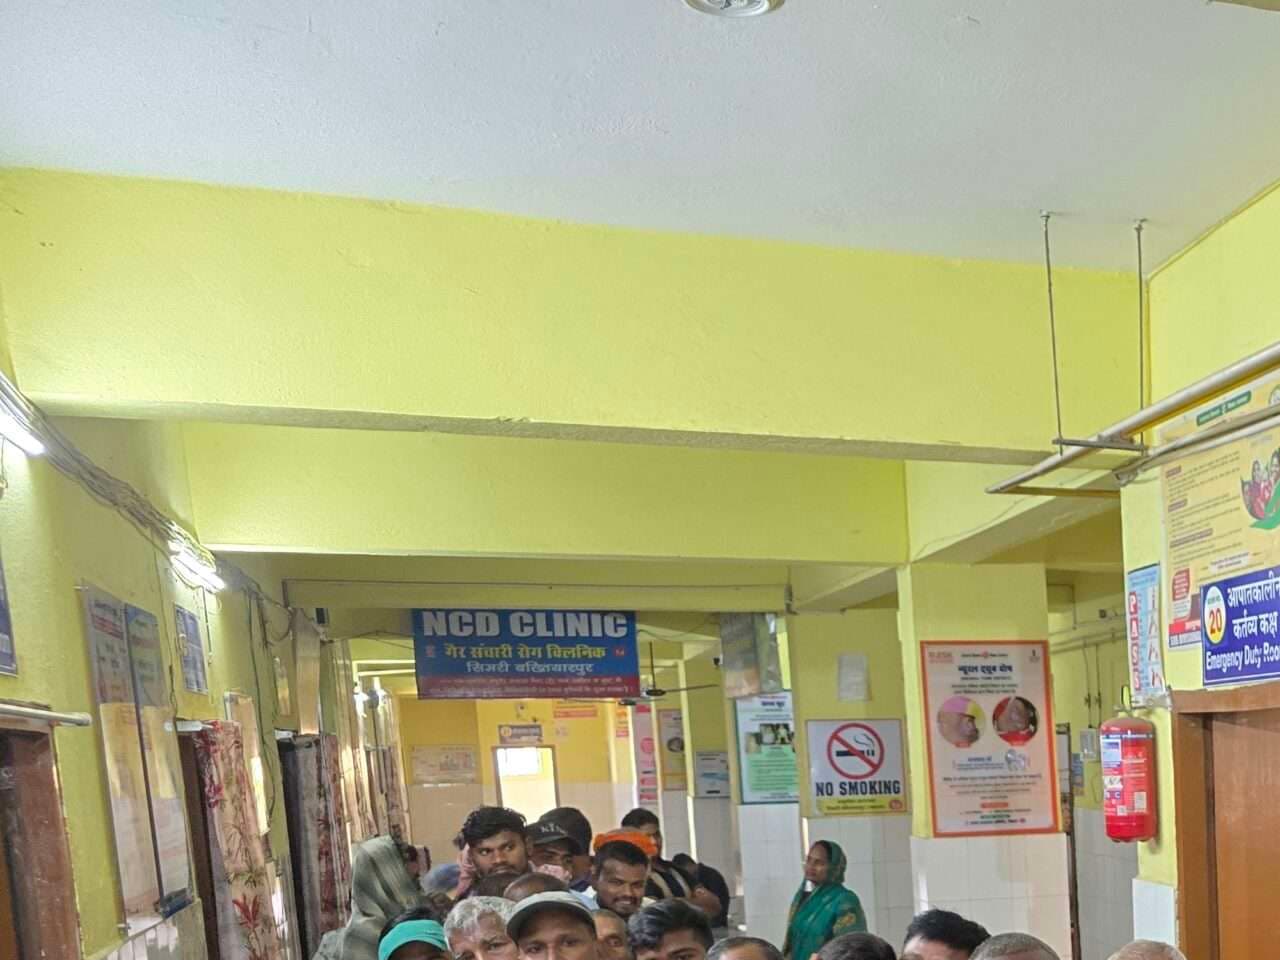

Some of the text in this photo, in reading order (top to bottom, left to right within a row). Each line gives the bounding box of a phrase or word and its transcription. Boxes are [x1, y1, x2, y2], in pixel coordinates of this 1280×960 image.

[422, 610, 628, 638] NCD CLINIC
[1209, 607, 1223, 634] 20
[1206, 651, 1243, 673] Emergency
[1244, 644, 1262, 668] Duty
[816, 780, 900, 797] NO SMOKING
